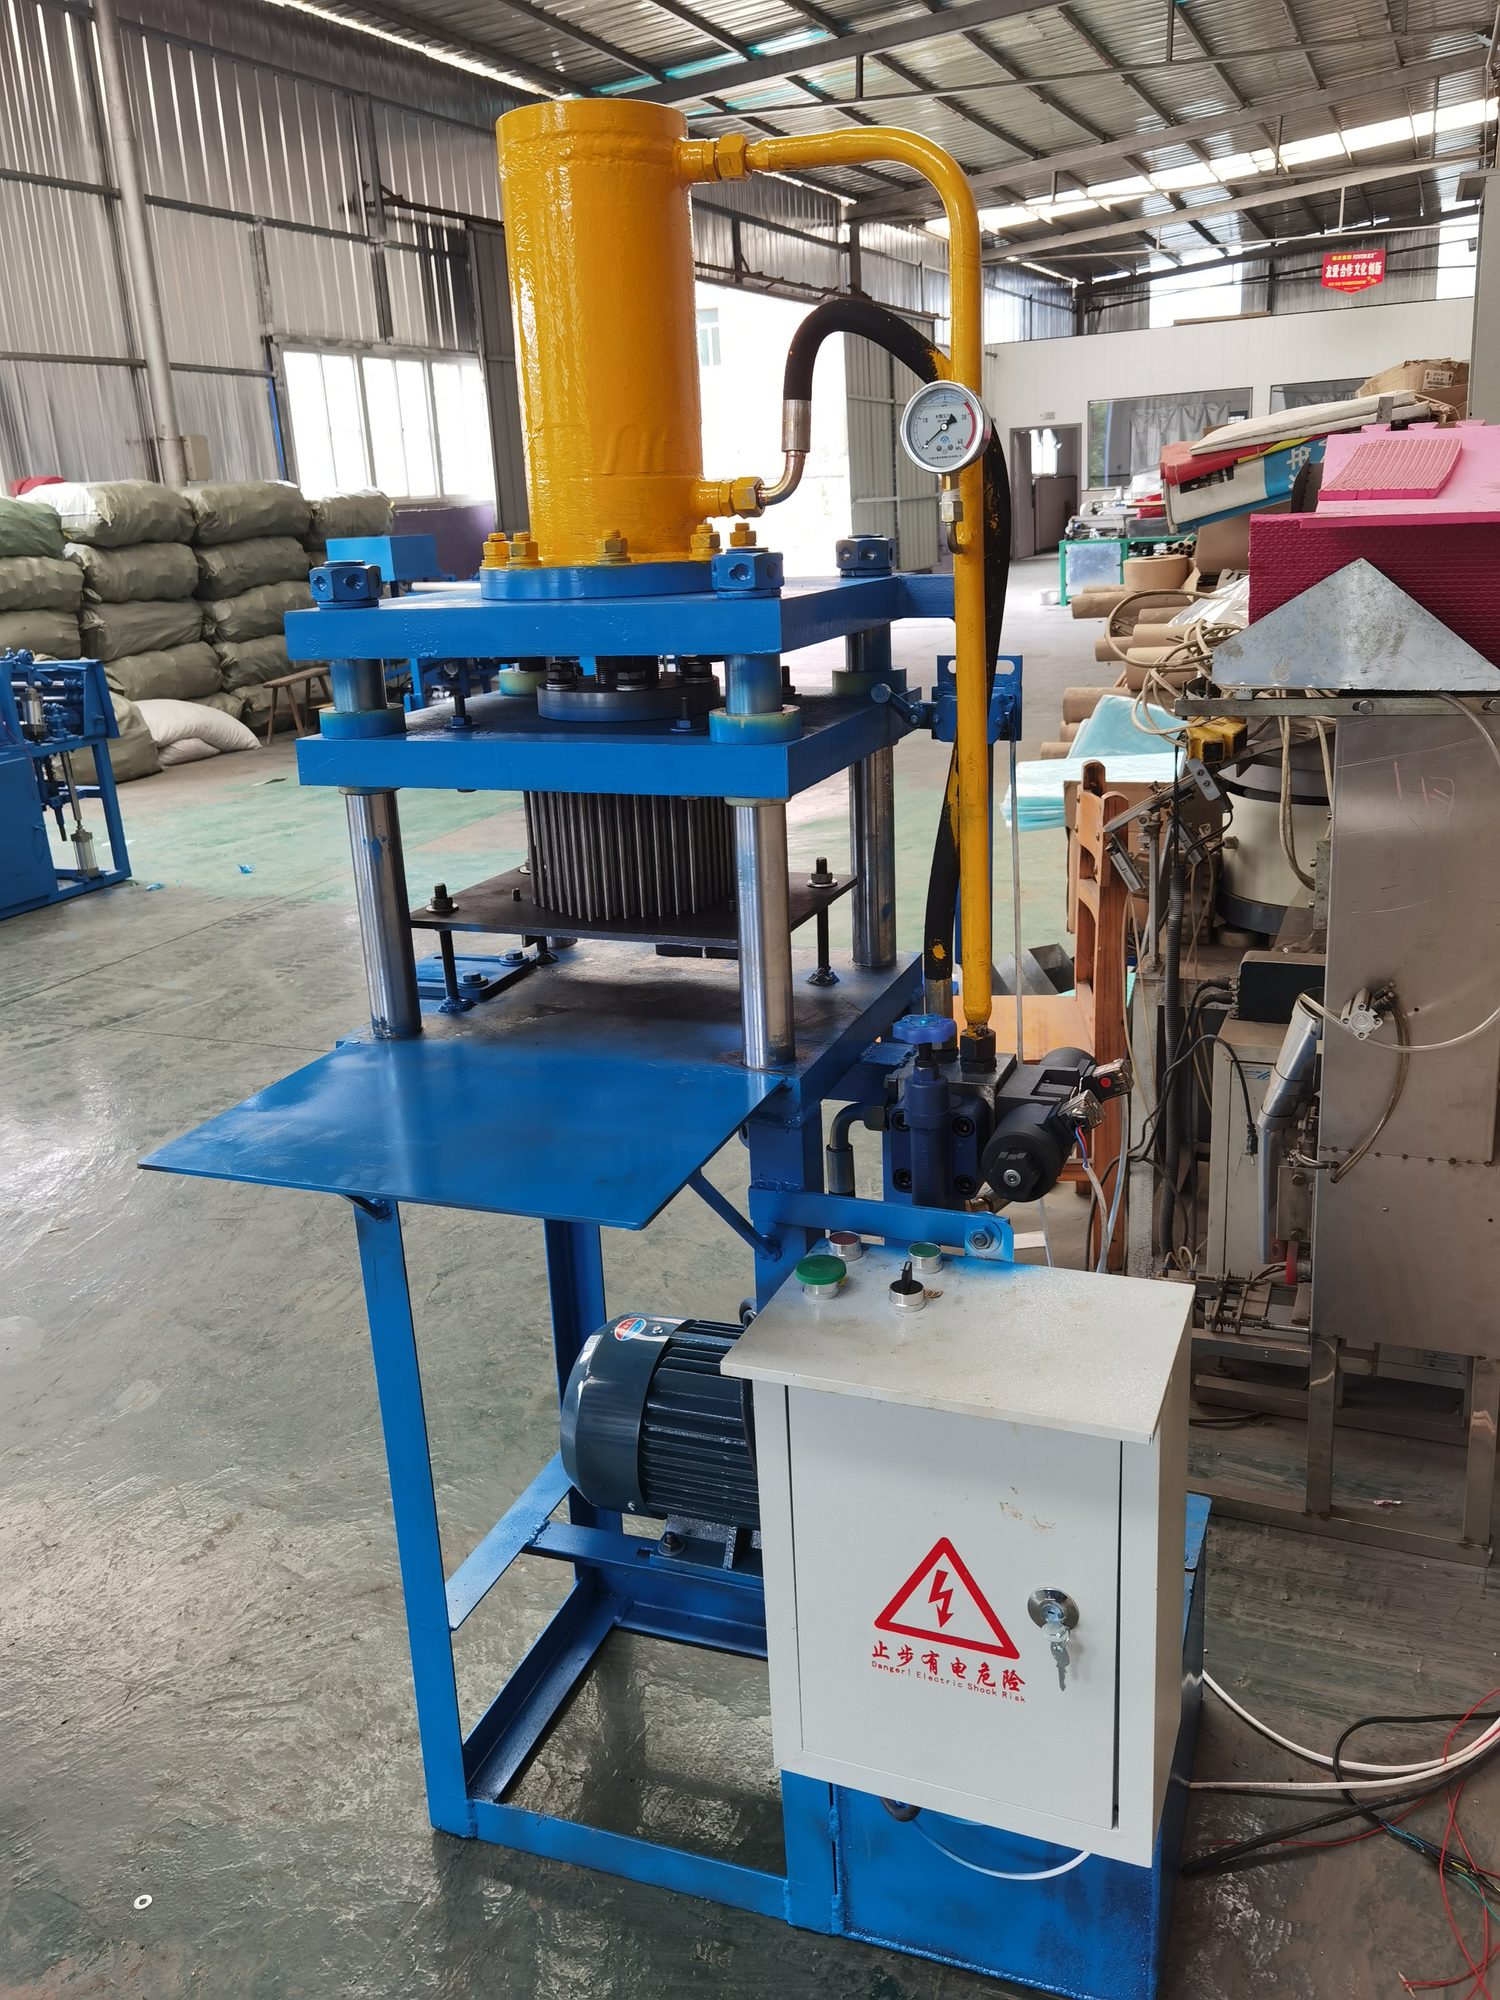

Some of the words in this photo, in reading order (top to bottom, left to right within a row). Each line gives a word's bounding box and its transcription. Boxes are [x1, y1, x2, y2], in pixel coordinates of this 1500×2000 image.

[871, 1660, 912, 1677] Danger!
[916, 1671, 963, 1688] Electric
[967, 1683, 998, 1697] Shock
[1002, 1691, 1026, 1703] Risk
[872, 1640, 1026, 1692] 止步有电危险
